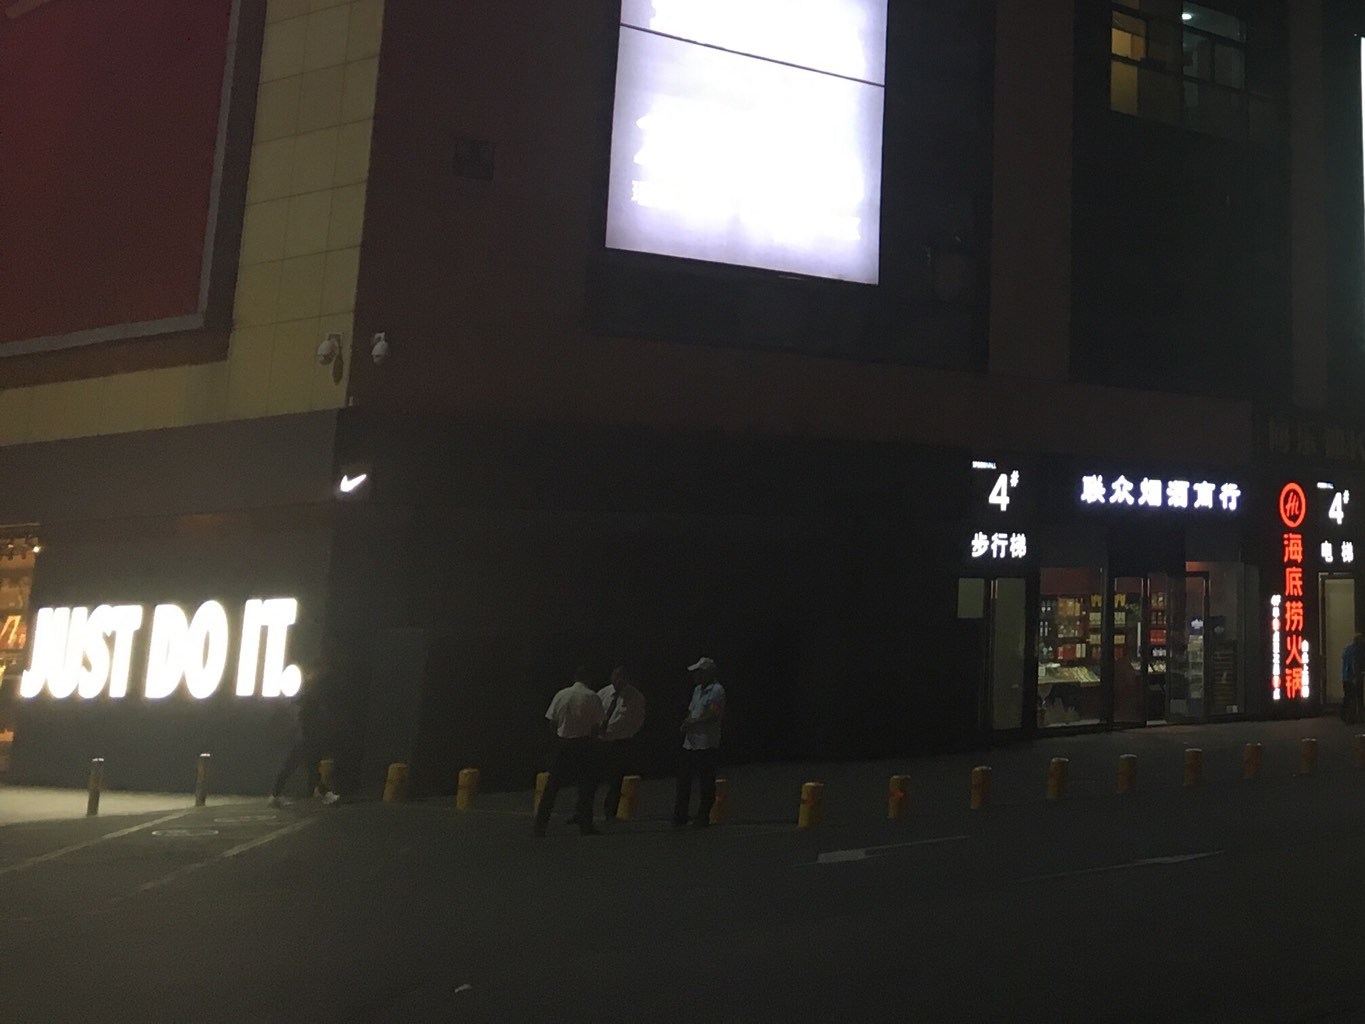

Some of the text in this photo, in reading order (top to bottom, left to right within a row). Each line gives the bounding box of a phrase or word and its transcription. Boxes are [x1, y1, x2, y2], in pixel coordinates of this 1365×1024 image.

[971, 531, 1027, 559] 步行梯
[20, 597, 302, 699] JUST DO IT.
[1282, 533, 1305, 700] 海底捞火锅
